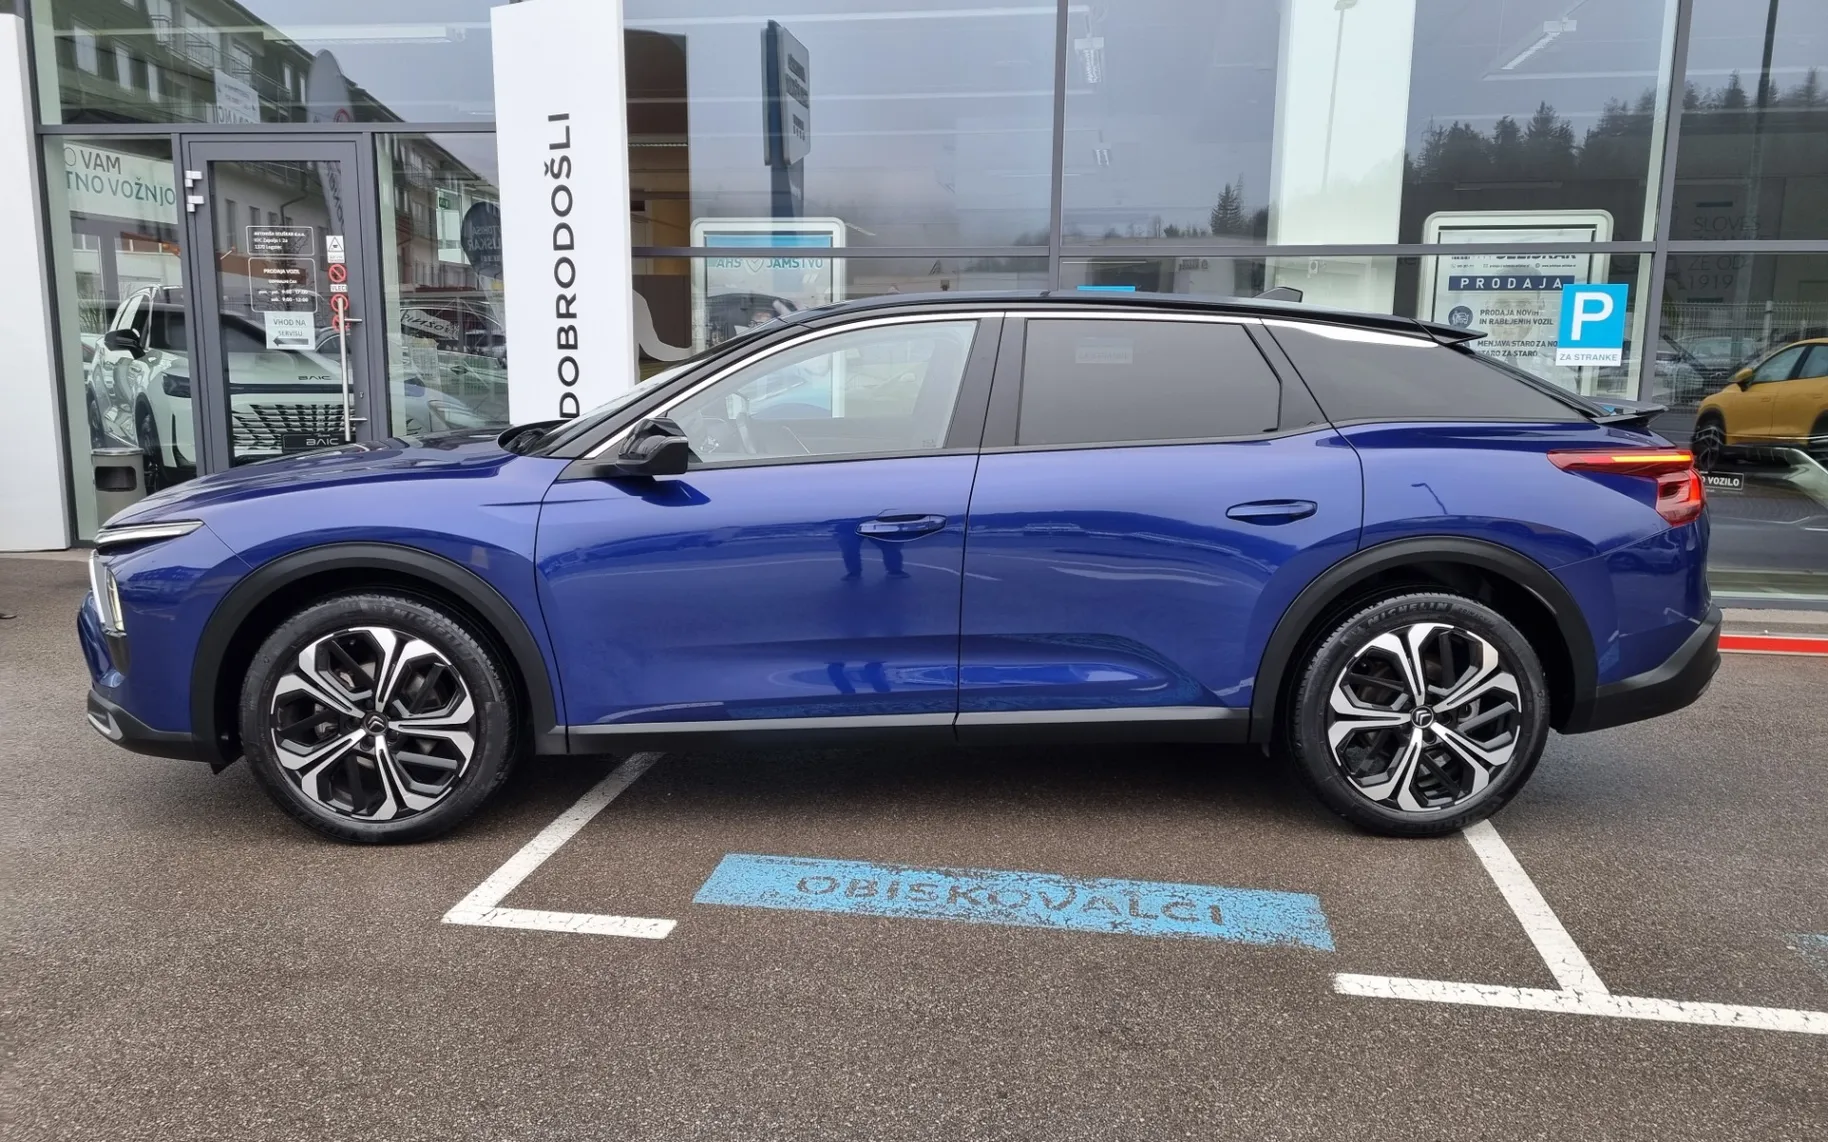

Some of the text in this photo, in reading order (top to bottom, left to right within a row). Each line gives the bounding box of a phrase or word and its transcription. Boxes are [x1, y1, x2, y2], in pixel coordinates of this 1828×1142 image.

[80, 150, 121, 174] VAM
[108, 177, 176, 206] VOŽNJO
[544, 113, 580, 418] DOBRODOŠLI
[1460, 278, 1562, 289] PRODAJA
[1690, 275, 1734, 289] 1919
[1532, 318, 1554, 326] VOZIL
[1571, 292, 1614, 341] P
[1559, 353, 1619, 361] ZA STRANKE
[306, 438, 339, 446] BAIC
[1707, 476, 1740, 487] VOZILO
[797, 876, 1224, 926] OBISKOVALCI
